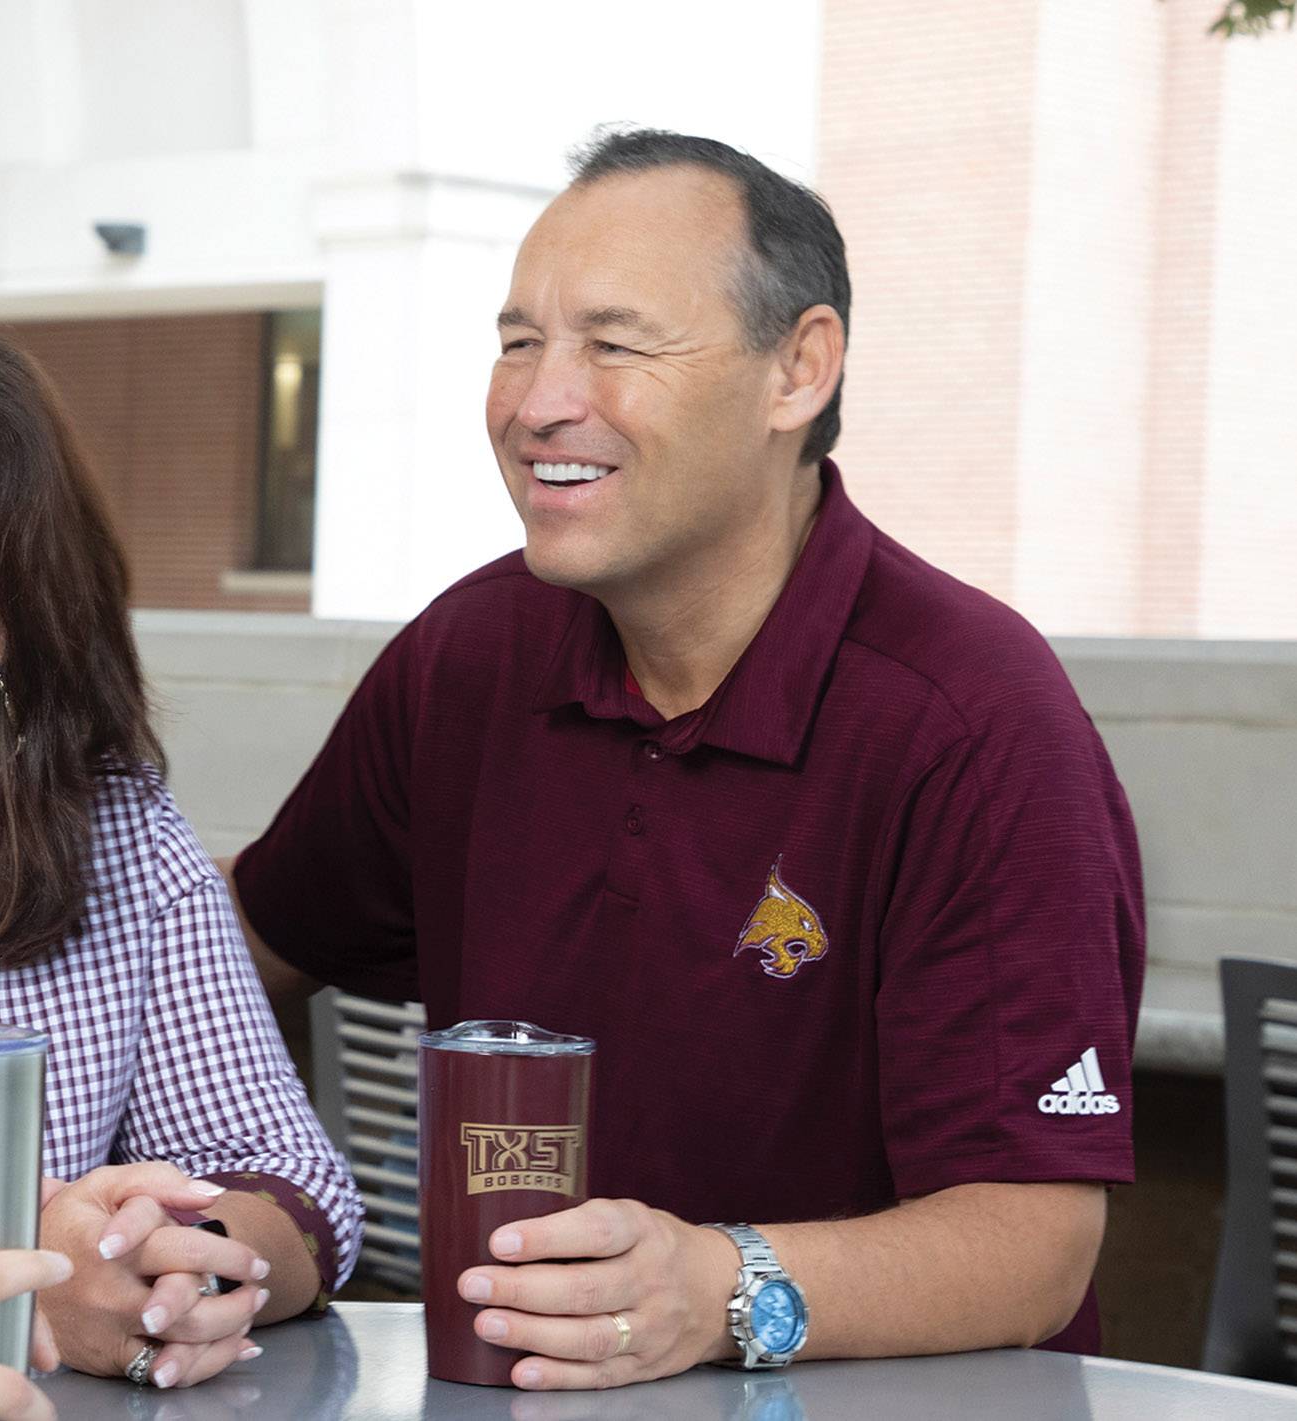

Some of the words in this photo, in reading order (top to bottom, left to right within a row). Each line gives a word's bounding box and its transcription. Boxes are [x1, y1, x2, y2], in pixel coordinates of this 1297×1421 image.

[1038, 1091, 1120, 1114] adidas
[465, 1128, 580, 1174] TXST
[484, 1174, 563, 1189] BOBCATS
